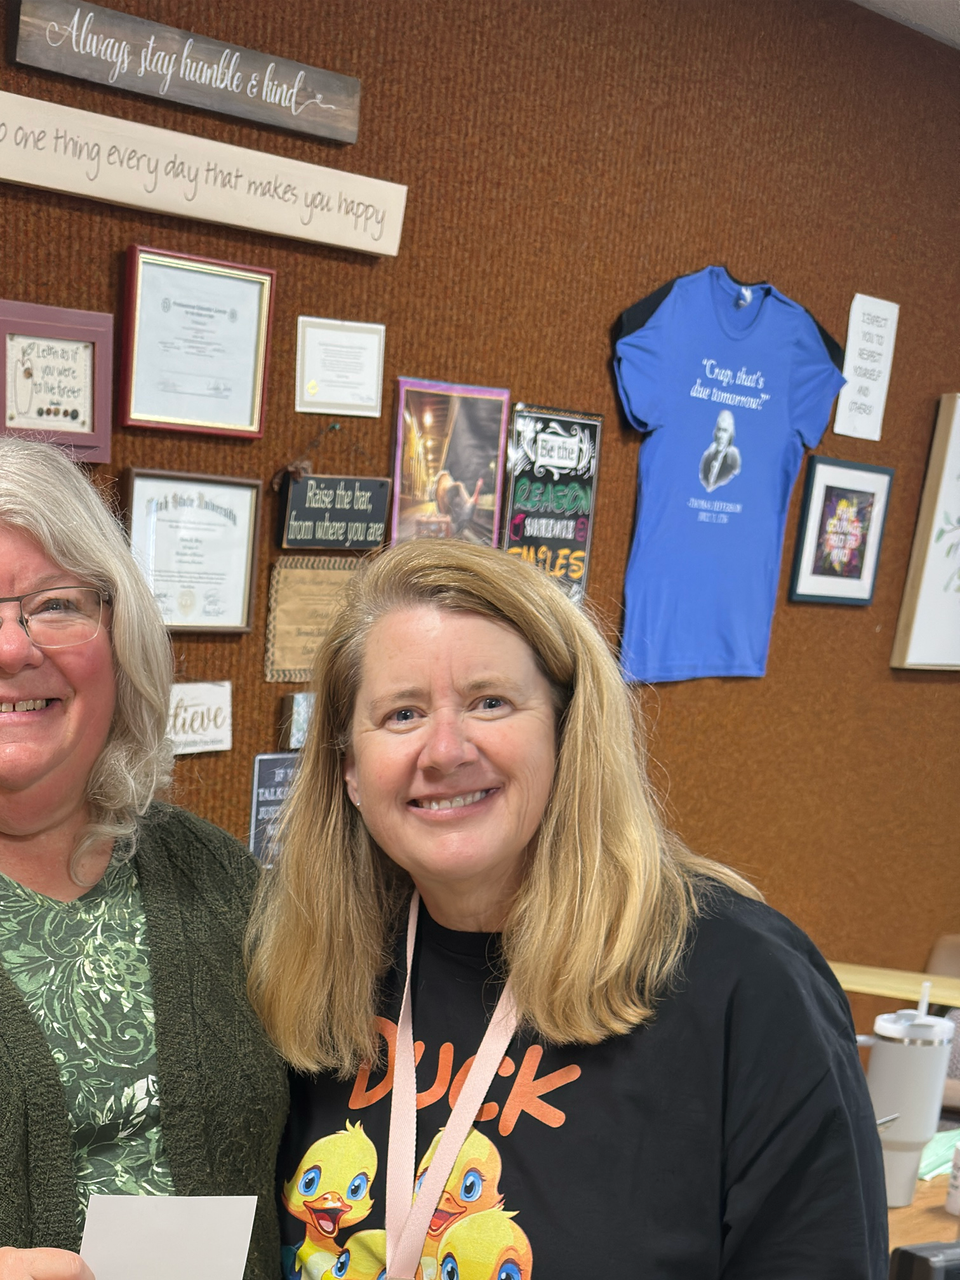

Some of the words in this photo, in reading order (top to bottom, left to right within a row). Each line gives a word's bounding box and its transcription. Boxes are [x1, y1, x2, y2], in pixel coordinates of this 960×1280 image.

[46, 8, 131, 82] Always
[138, 35, 177, 95] stay
[180, 38, 244, 92] humble
[246, 73, 259, 97] &
[262, 63, 312, 116] kind
[14, 126, 46, 151] one
[53, 128, 100, 182] thing
[107, 145, 159, 193] every
[164, 154, 199, 202] day
[205, 161, 242, 190] that
[247, 174, 298, 204] makes
[300, 191, 333, 226] you
[338, 191, 386, 241] happy
[41, 364, 55, 379] you
[57, 365, 77, 380] were
[305, 480, 334, 509] Raise
[335, 481, 352, 509] the
[354, 481, 372, 514] bar,
[514, 476, 592, 516] REASON
[288, 510, 314, 540] from
[315, 511, 346, 540] where
[345, 522, 367, 547] you
[367, 522, 385, 541] are
[172, 698, 227, 736] lieve
[348, 1016, 581, 1136] DUCK
